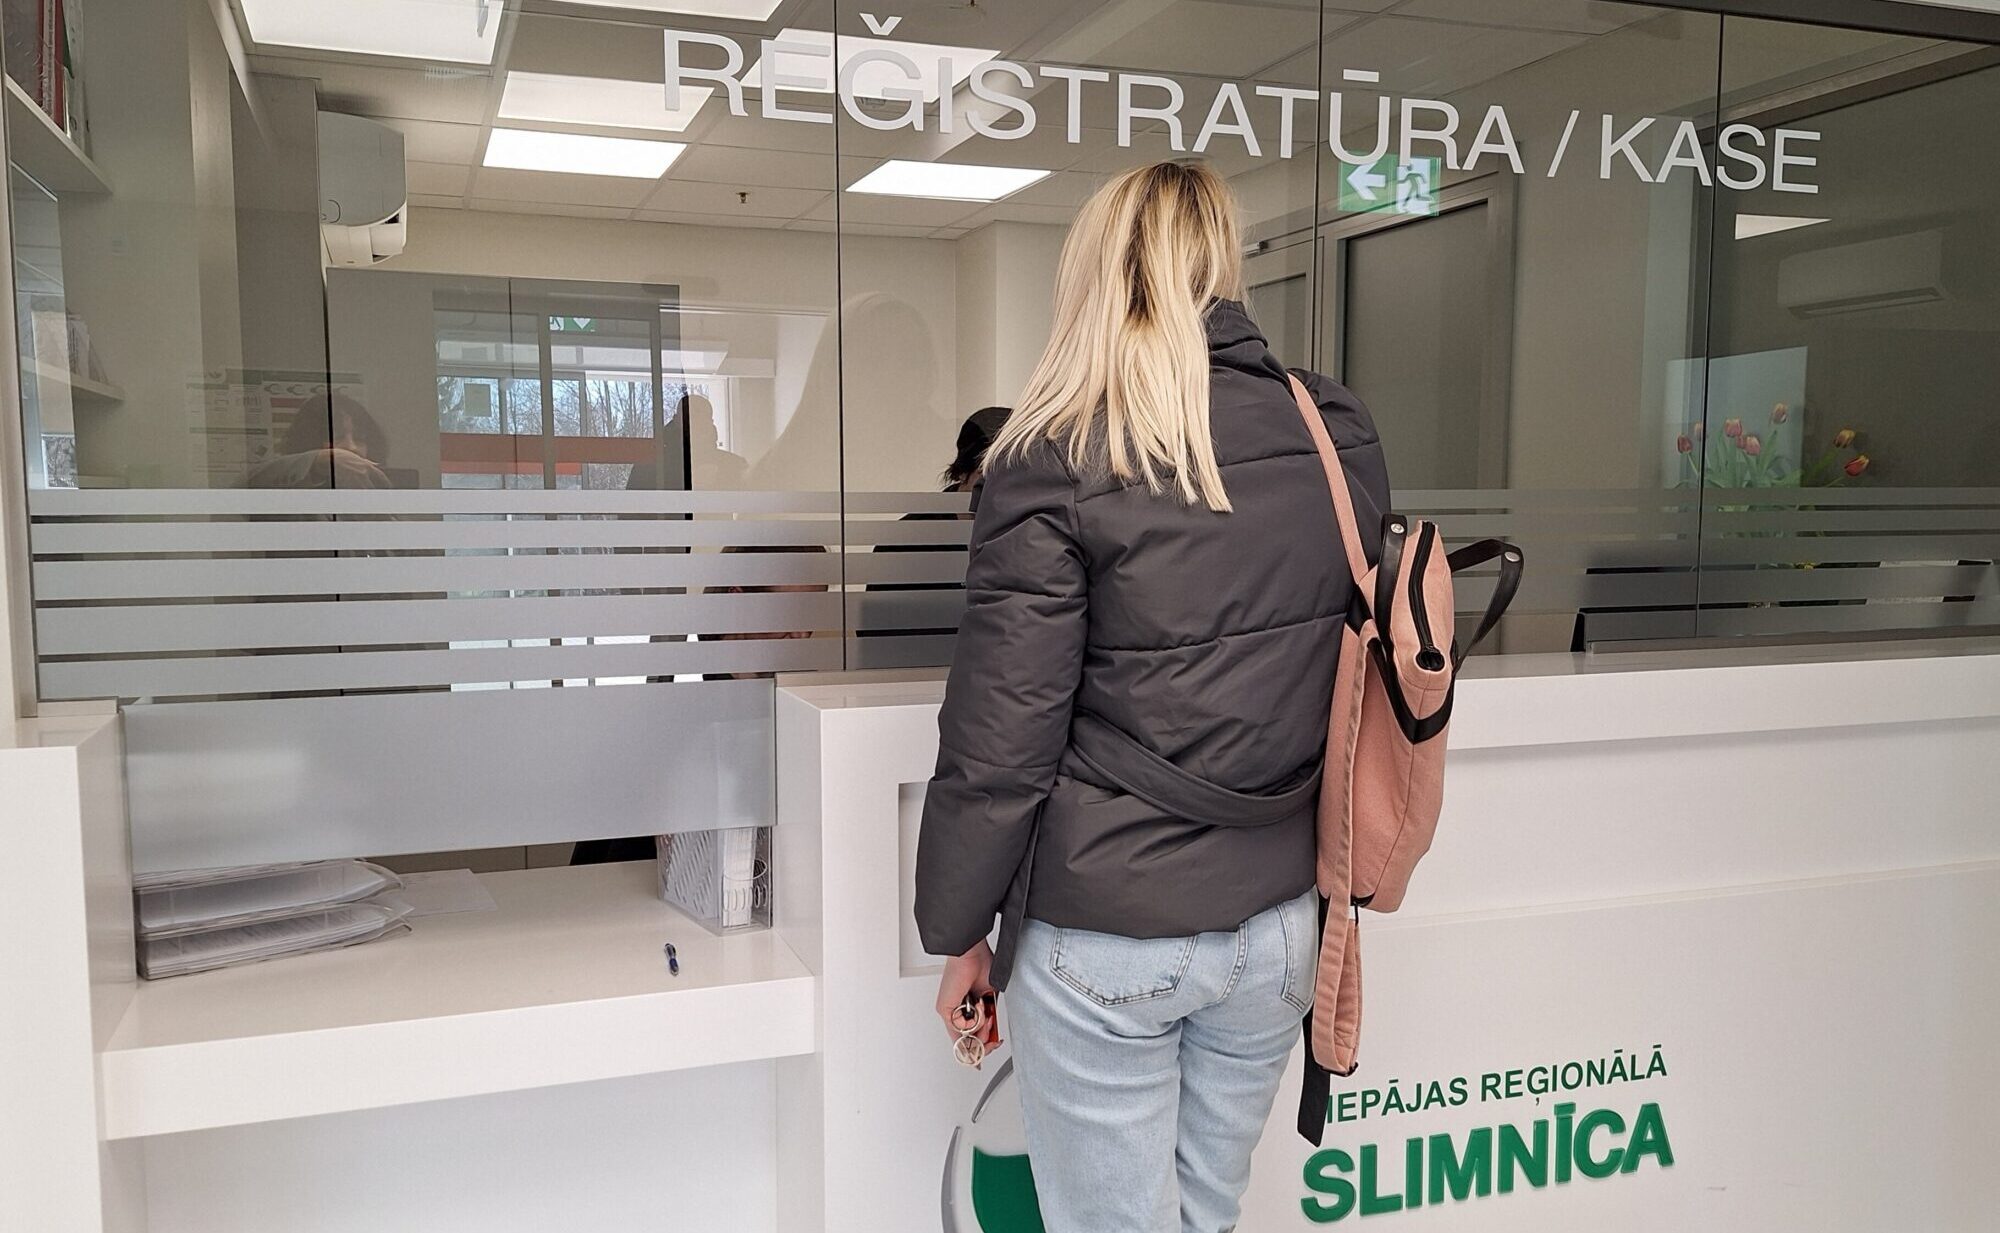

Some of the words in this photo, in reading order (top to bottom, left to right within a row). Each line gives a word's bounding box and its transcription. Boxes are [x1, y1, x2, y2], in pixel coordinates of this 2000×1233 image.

[1547, 110, 1580, 178] /
[1600, 114, 1821, 194] KASE
[1327, 1077, 1469, 1123] IEPĀJAS
[1481, 1045, 1668, 1105] REĢIONĀLĀ
[1300, 1102, 1675, 1224] SLIMNĪCA
